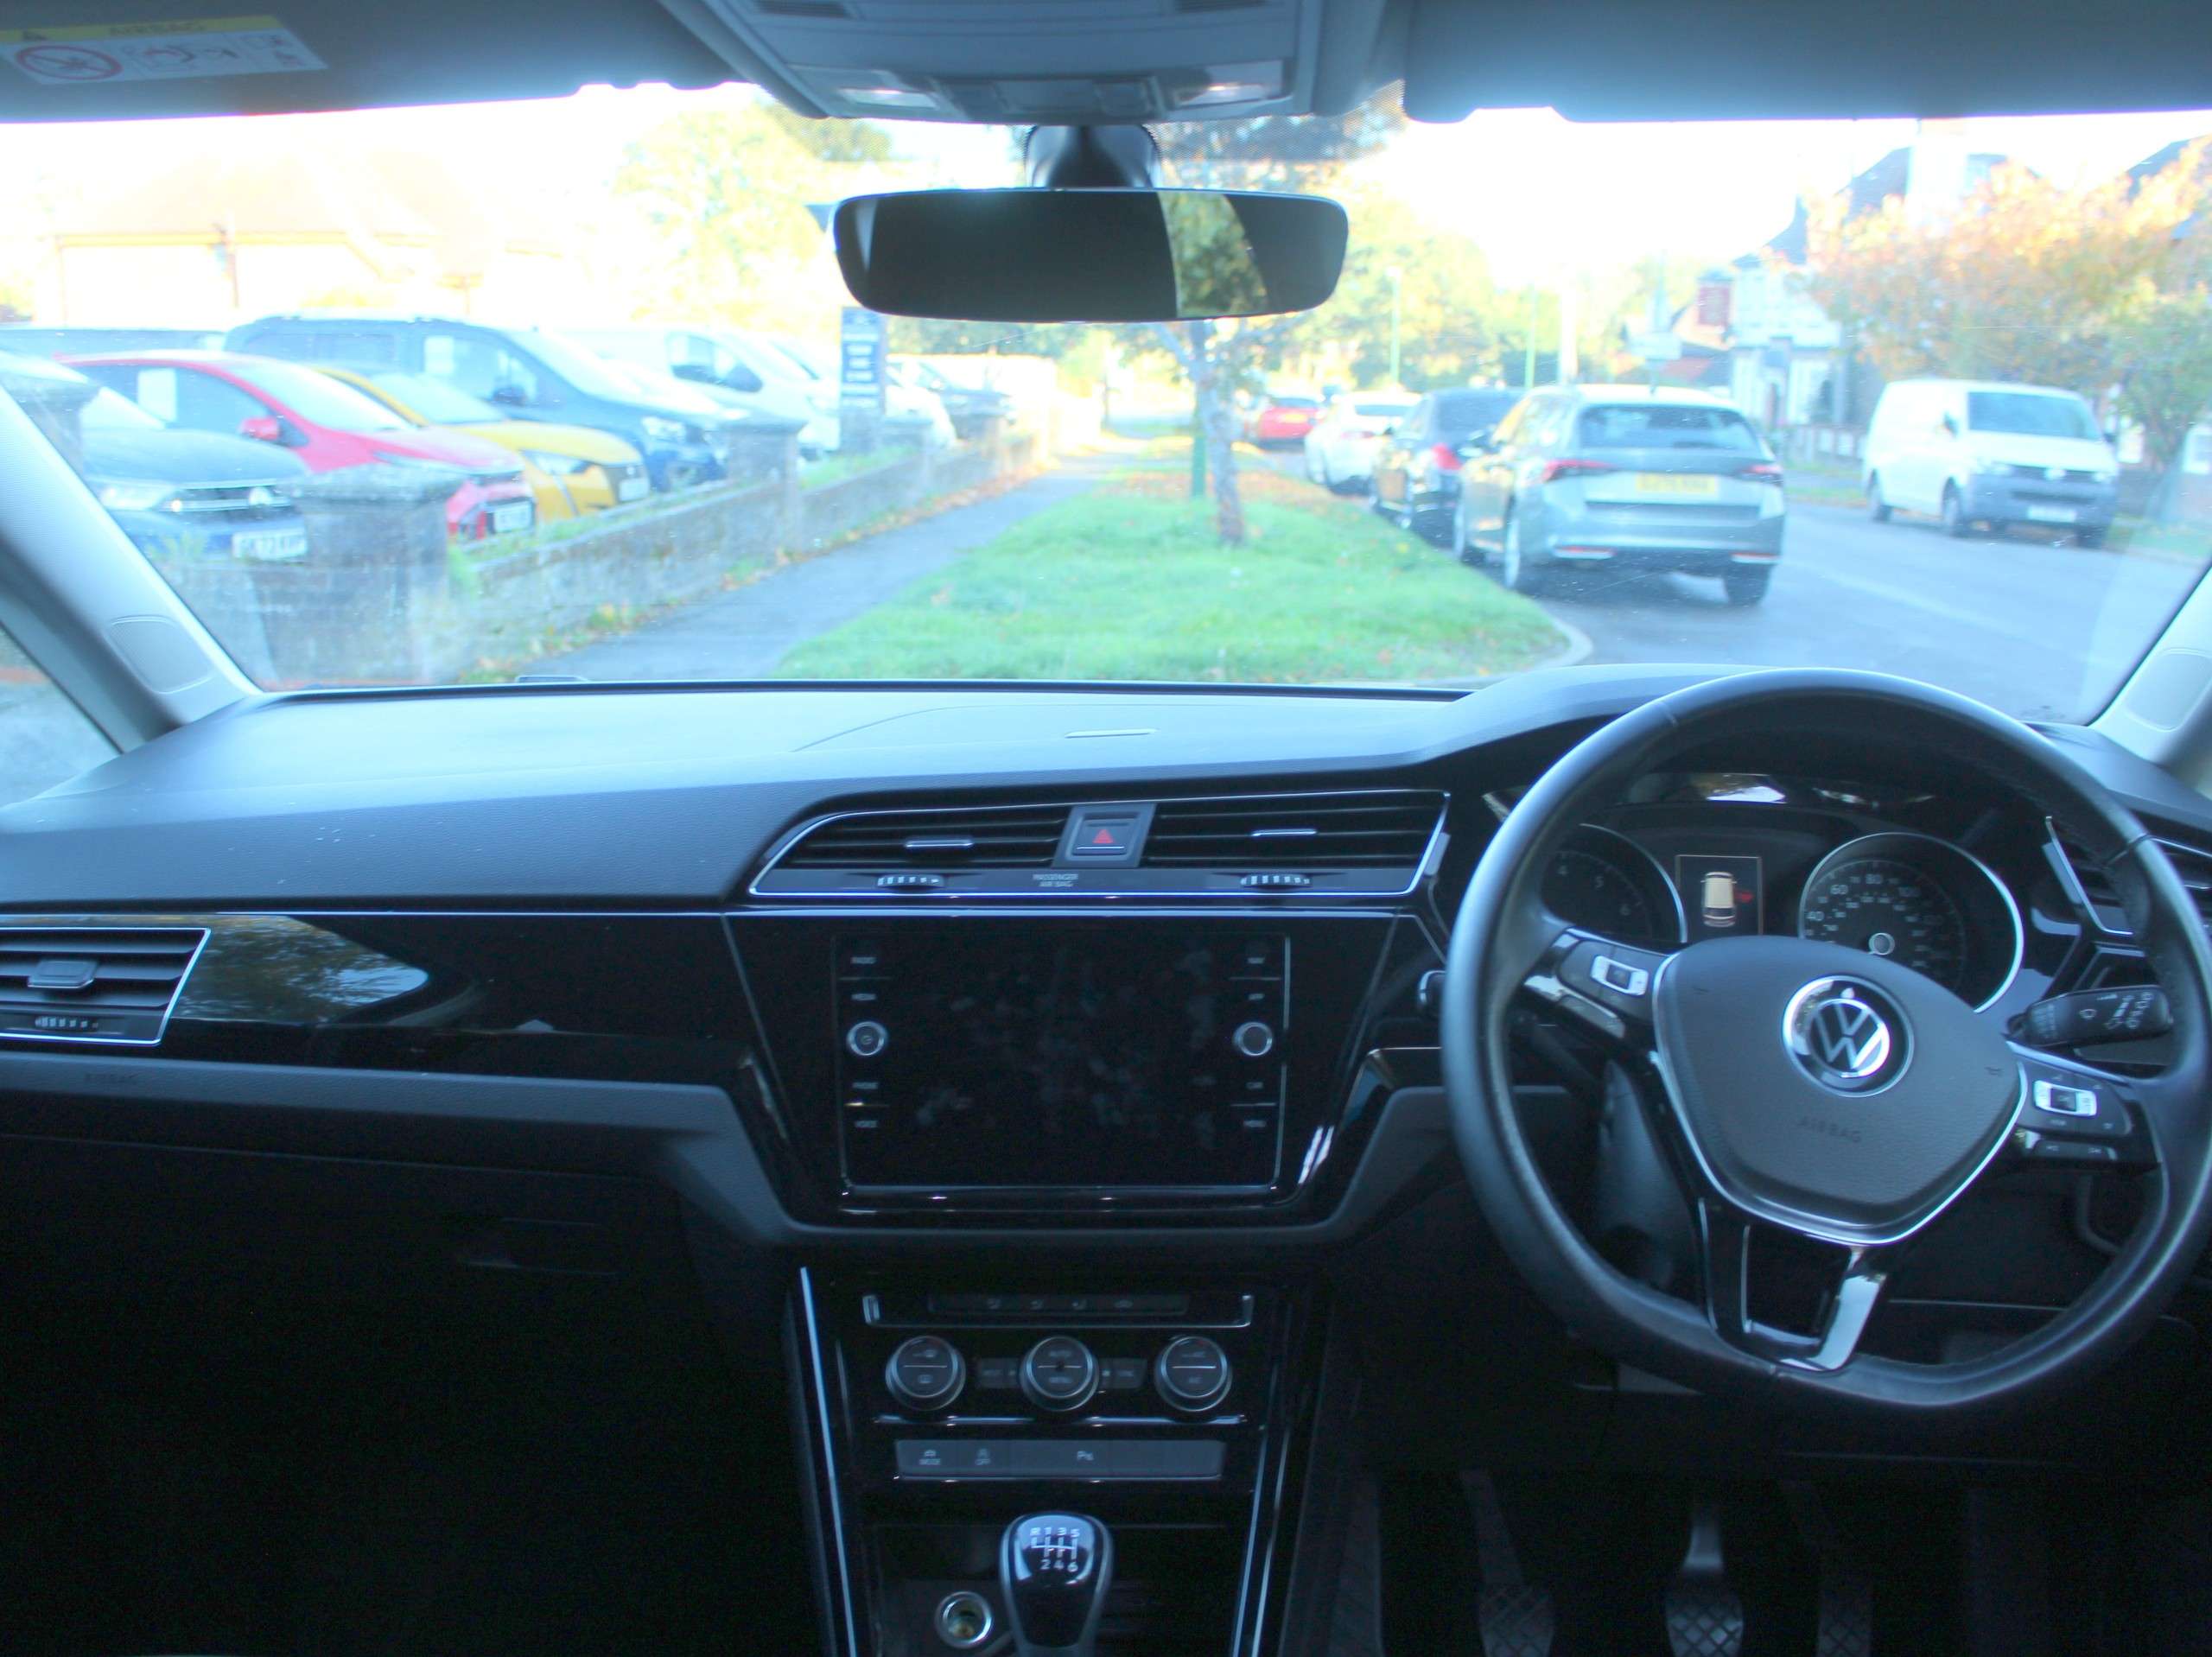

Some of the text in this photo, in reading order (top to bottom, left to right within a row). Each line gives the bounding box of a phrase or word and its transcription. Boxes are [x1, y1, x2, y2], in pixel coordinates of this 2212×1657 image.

[1865, 873, 1884, 885] 80
[1829, 884, 1849, 895] 60
[1806, 911, 1825, 922] 40
[1030, 1527, 1080, 1538] R 1 3 5
[1039, 1558, 1078, 1572] 2 4 6
